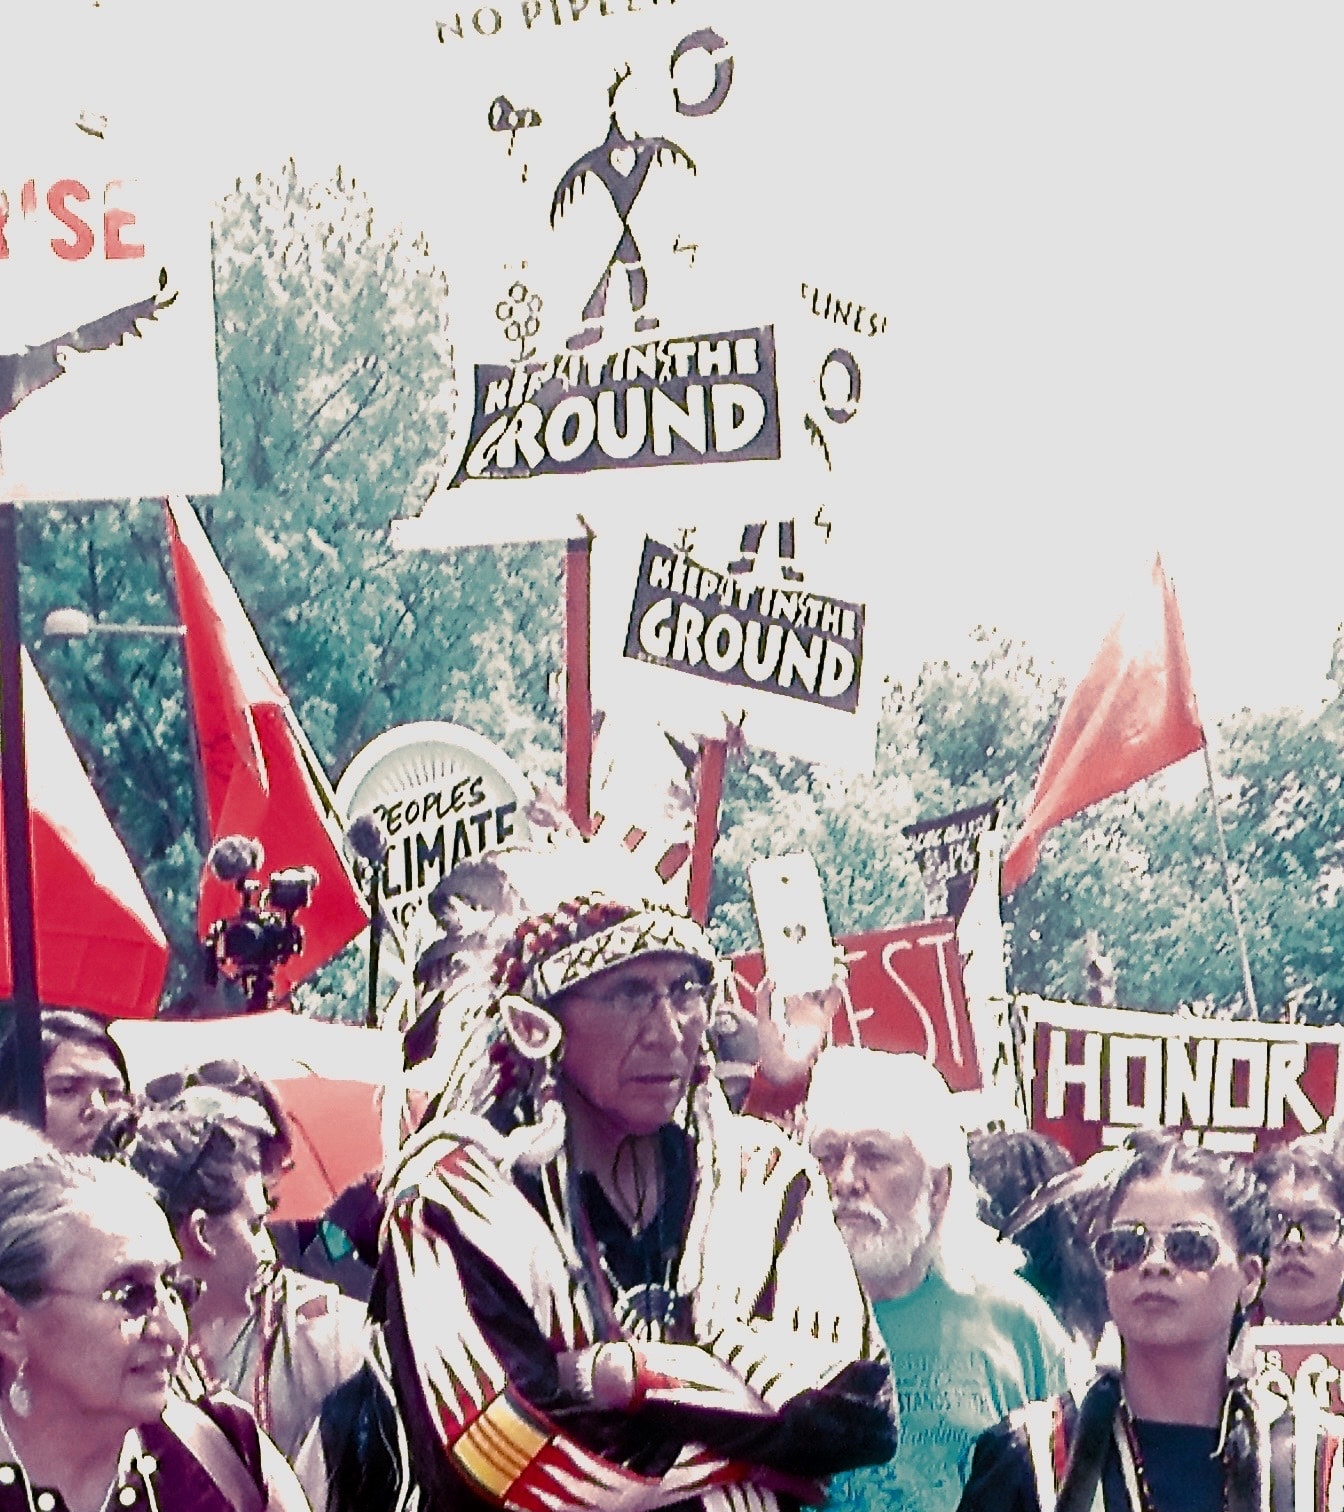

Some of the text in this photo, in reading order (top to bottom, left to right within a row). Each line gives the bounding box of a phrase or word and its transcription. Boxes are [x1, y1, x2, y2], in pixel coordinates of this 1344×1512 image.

[435, 7, 502, 43] NO
[465, 383, 767, 477] GROUND
[639, 597, 855, 697] GROUND
[352, 801, 517, 900] LIMATE
[1044, 1030, 1324, 1133] HONOR
